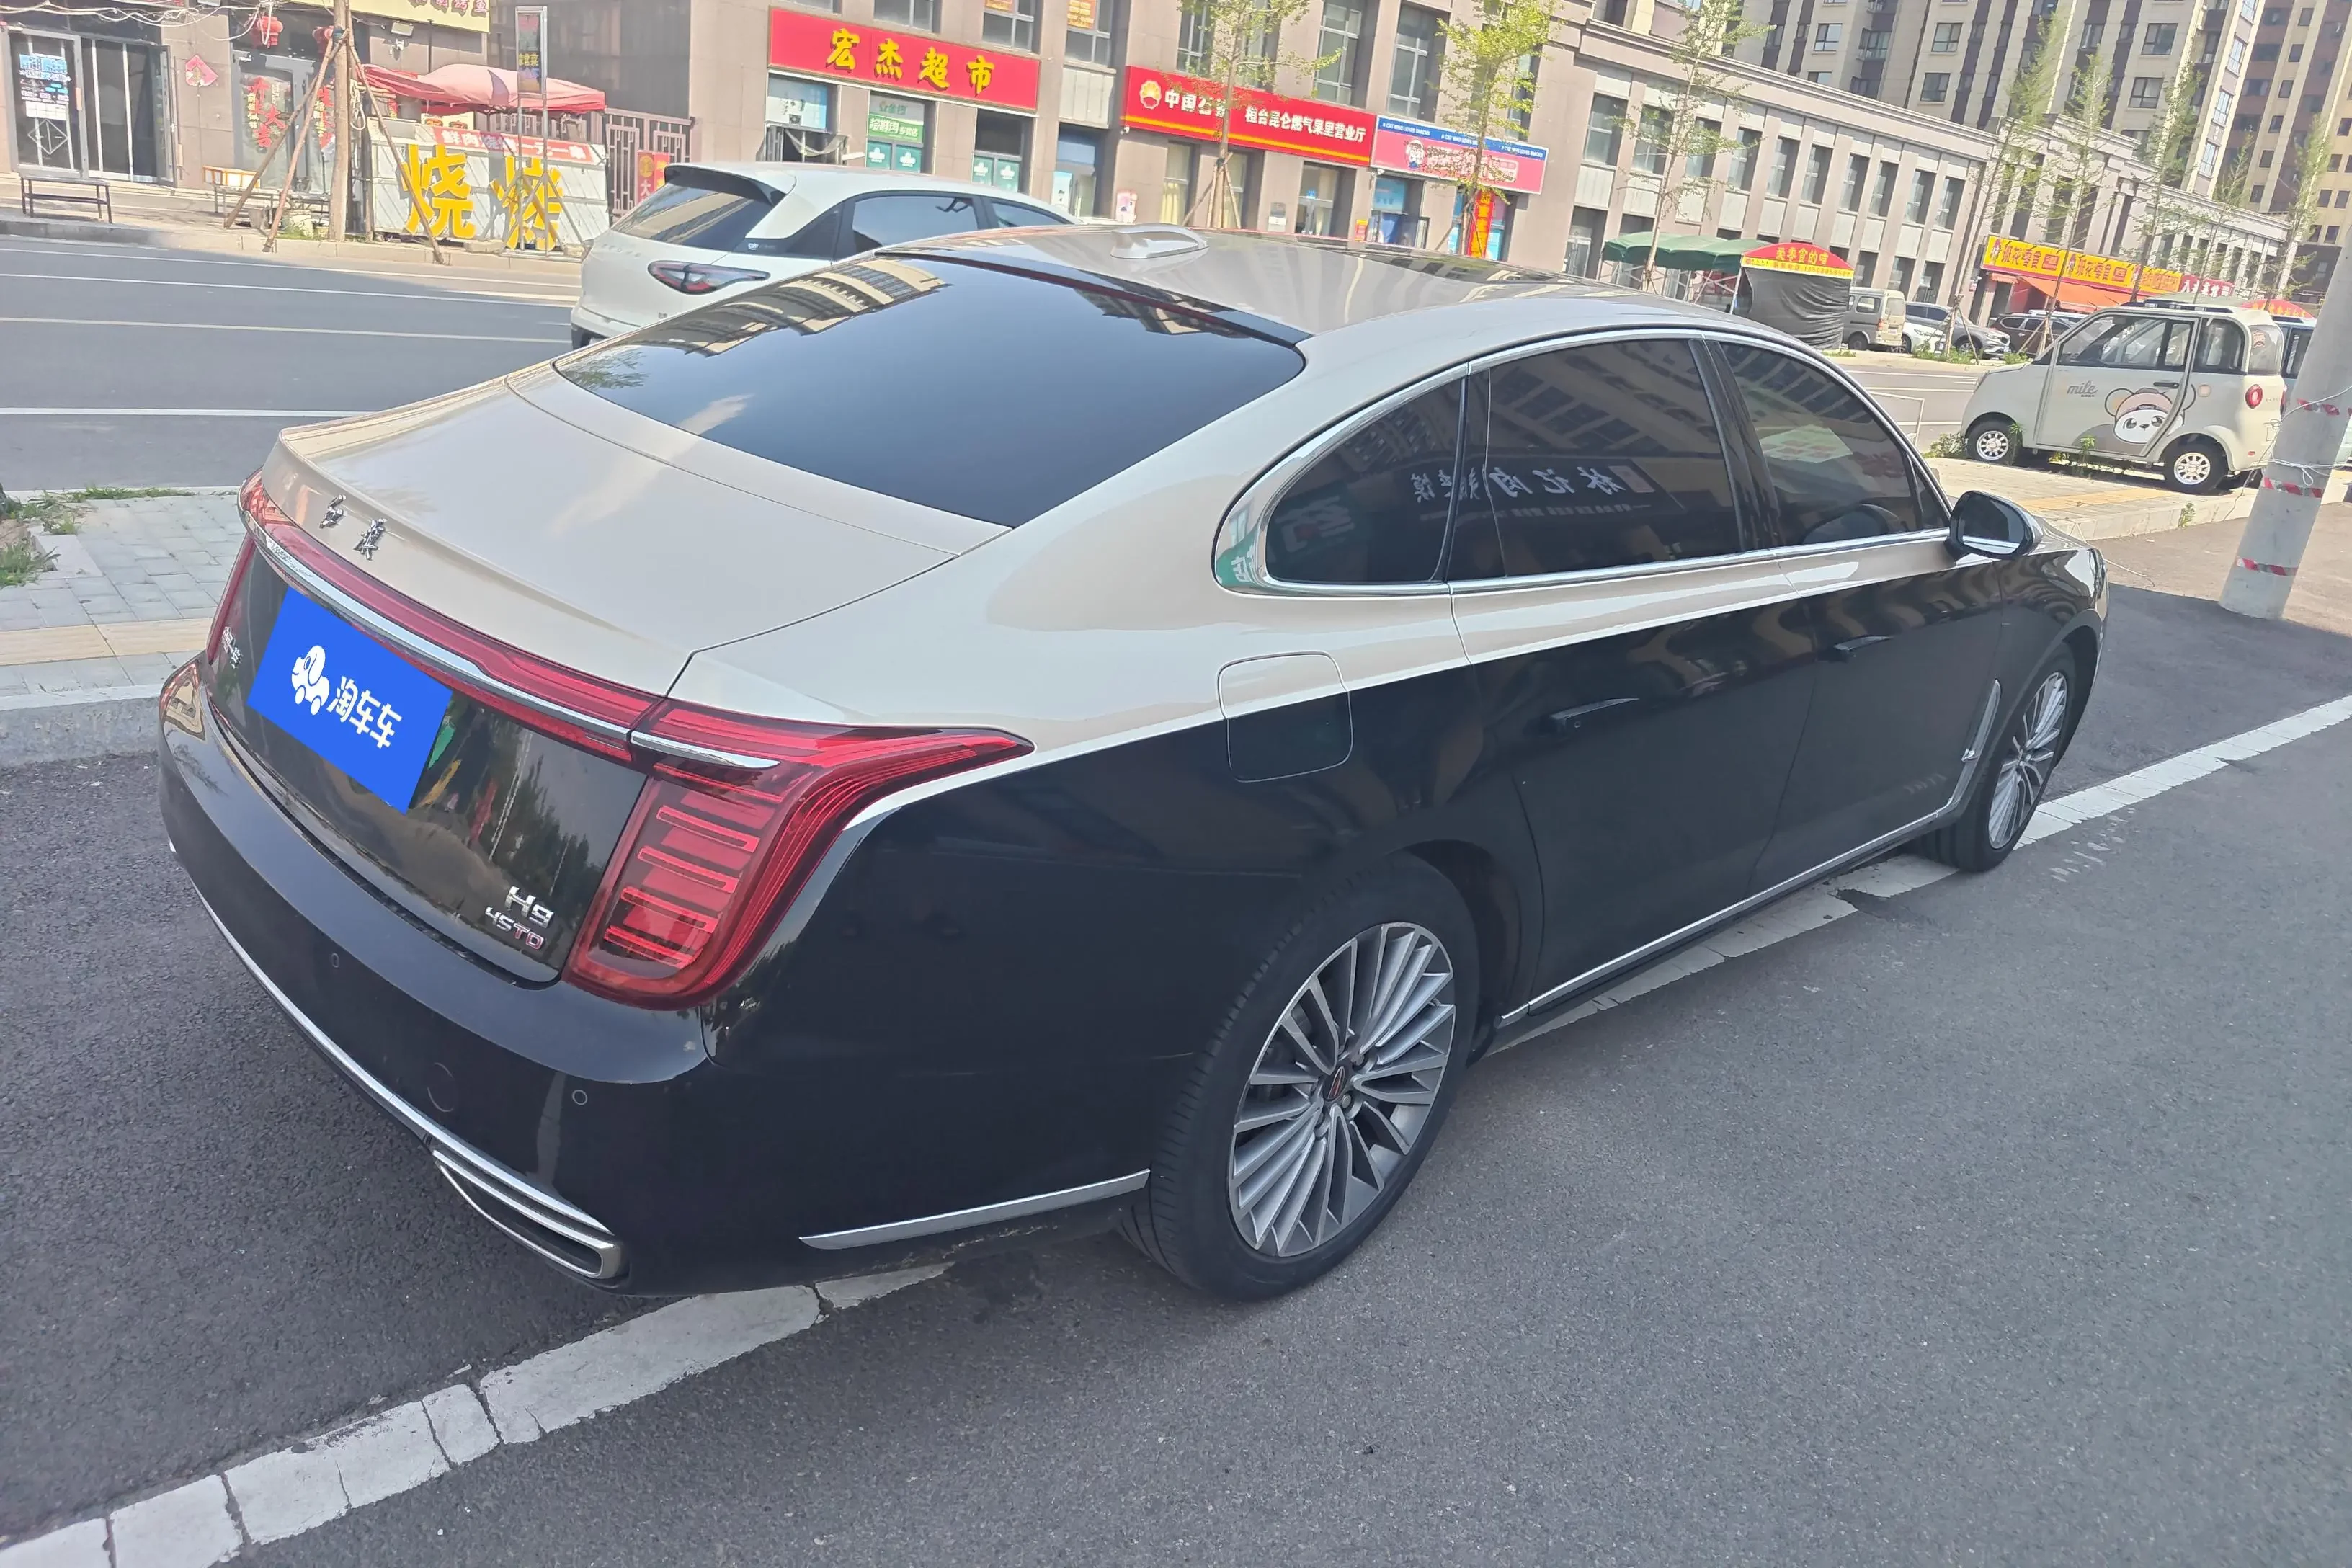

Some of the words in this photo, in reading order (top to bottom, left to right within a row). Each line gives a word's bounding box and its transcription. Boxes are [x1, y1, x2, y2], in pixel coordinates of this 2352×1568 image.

[826, 27, 995, 95] 宏杰超市
[2067, 380, 2098, 395] mile
[484, 906, 544, 950] 45TD
[504, 886, 553, 929] H9
